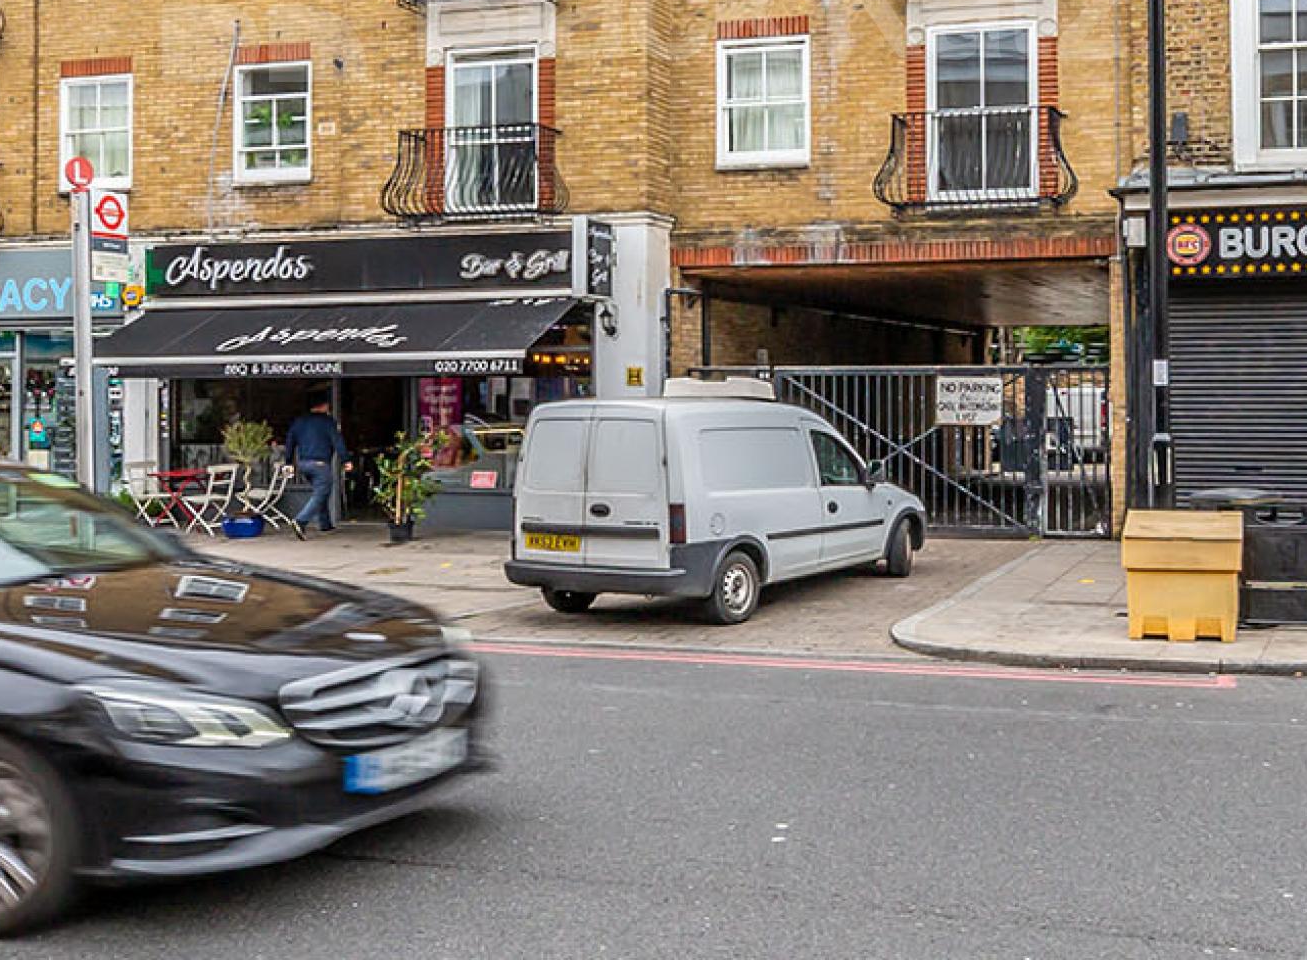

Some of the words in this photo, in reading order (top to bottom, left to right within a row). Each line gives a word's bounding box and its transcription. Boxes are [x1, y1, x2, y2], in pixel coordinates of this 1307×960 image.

[74, 161, 87, 184] L
[165, 246, 311, 290] Aspendos
[459, 252, 502, 280] Bar
[522, 248, 570, 280] Grill
[216, 323, 407, 352] Aspendos
[434, 361, 459, 374] 020
[459, 360, 489, 373] 7700
[490, 359, 519, 372] 6711
[940, 382, 956, 393] NO
[958, 381, 1001, 394] PARKING
